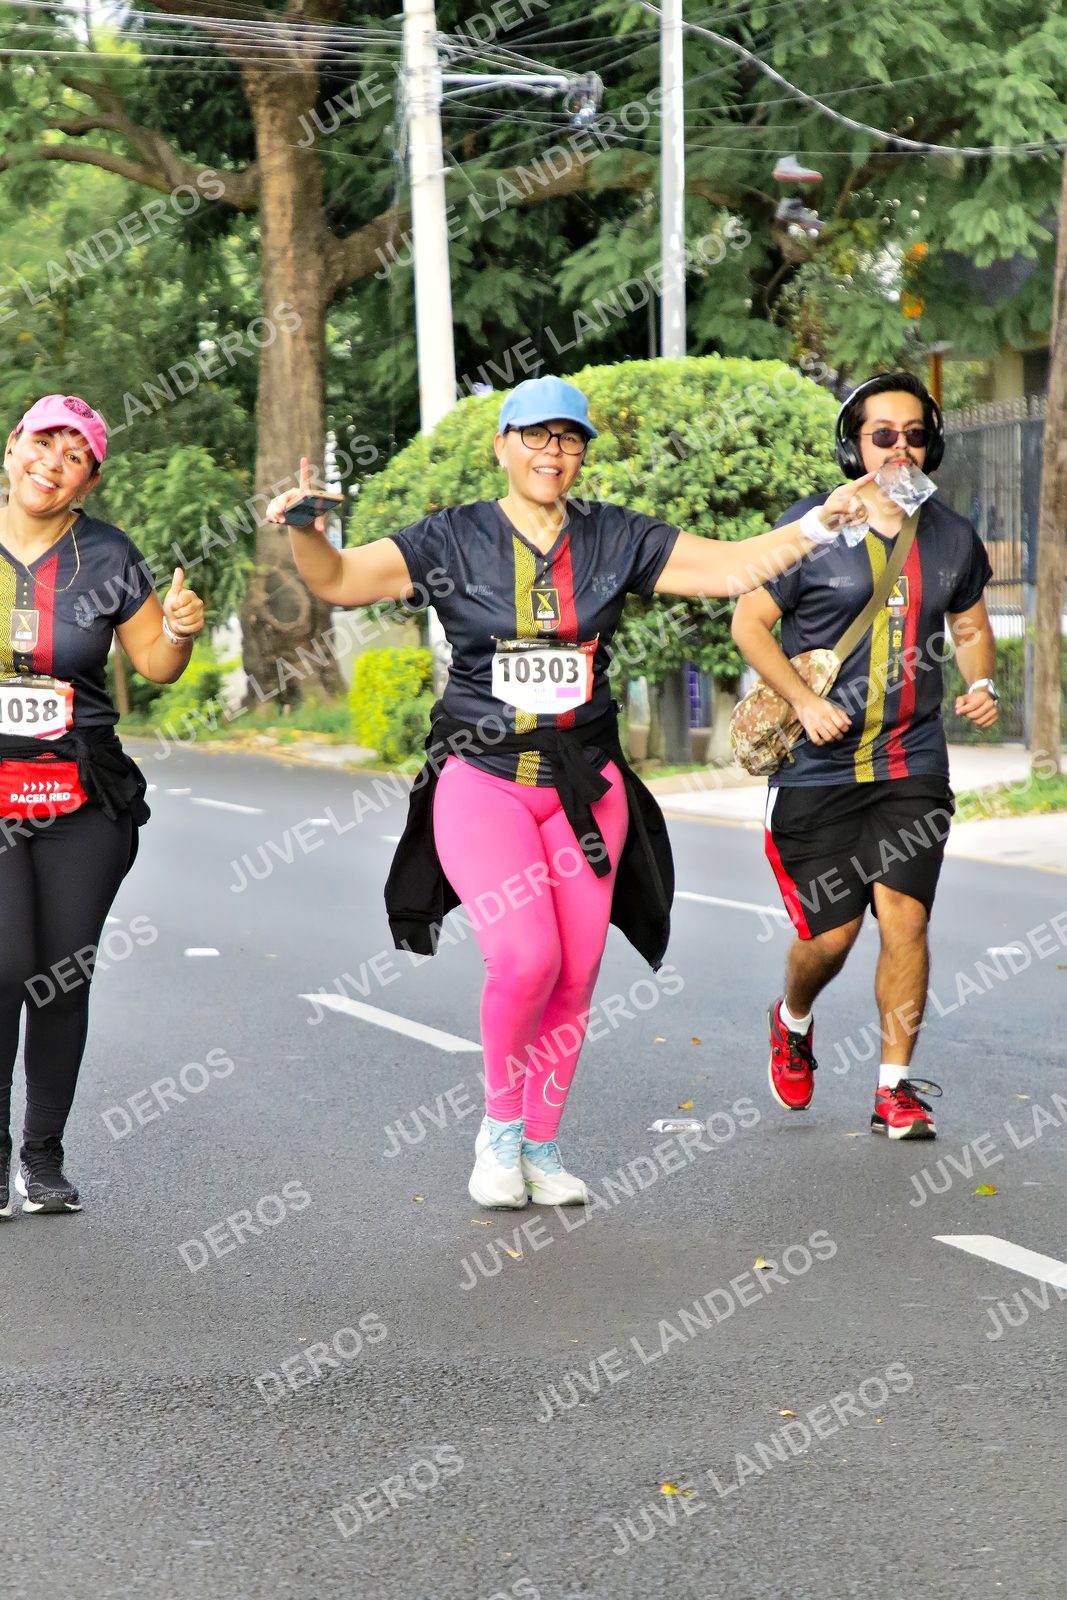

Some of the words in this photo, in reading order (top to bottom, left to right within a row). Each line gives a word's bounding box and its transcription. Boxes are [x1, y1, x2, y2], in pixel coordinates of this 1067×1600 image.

[498, 657, 579, 683] 10303
[10, 793, 46, 803] PACER
[49, 792, 71, 802] RED
